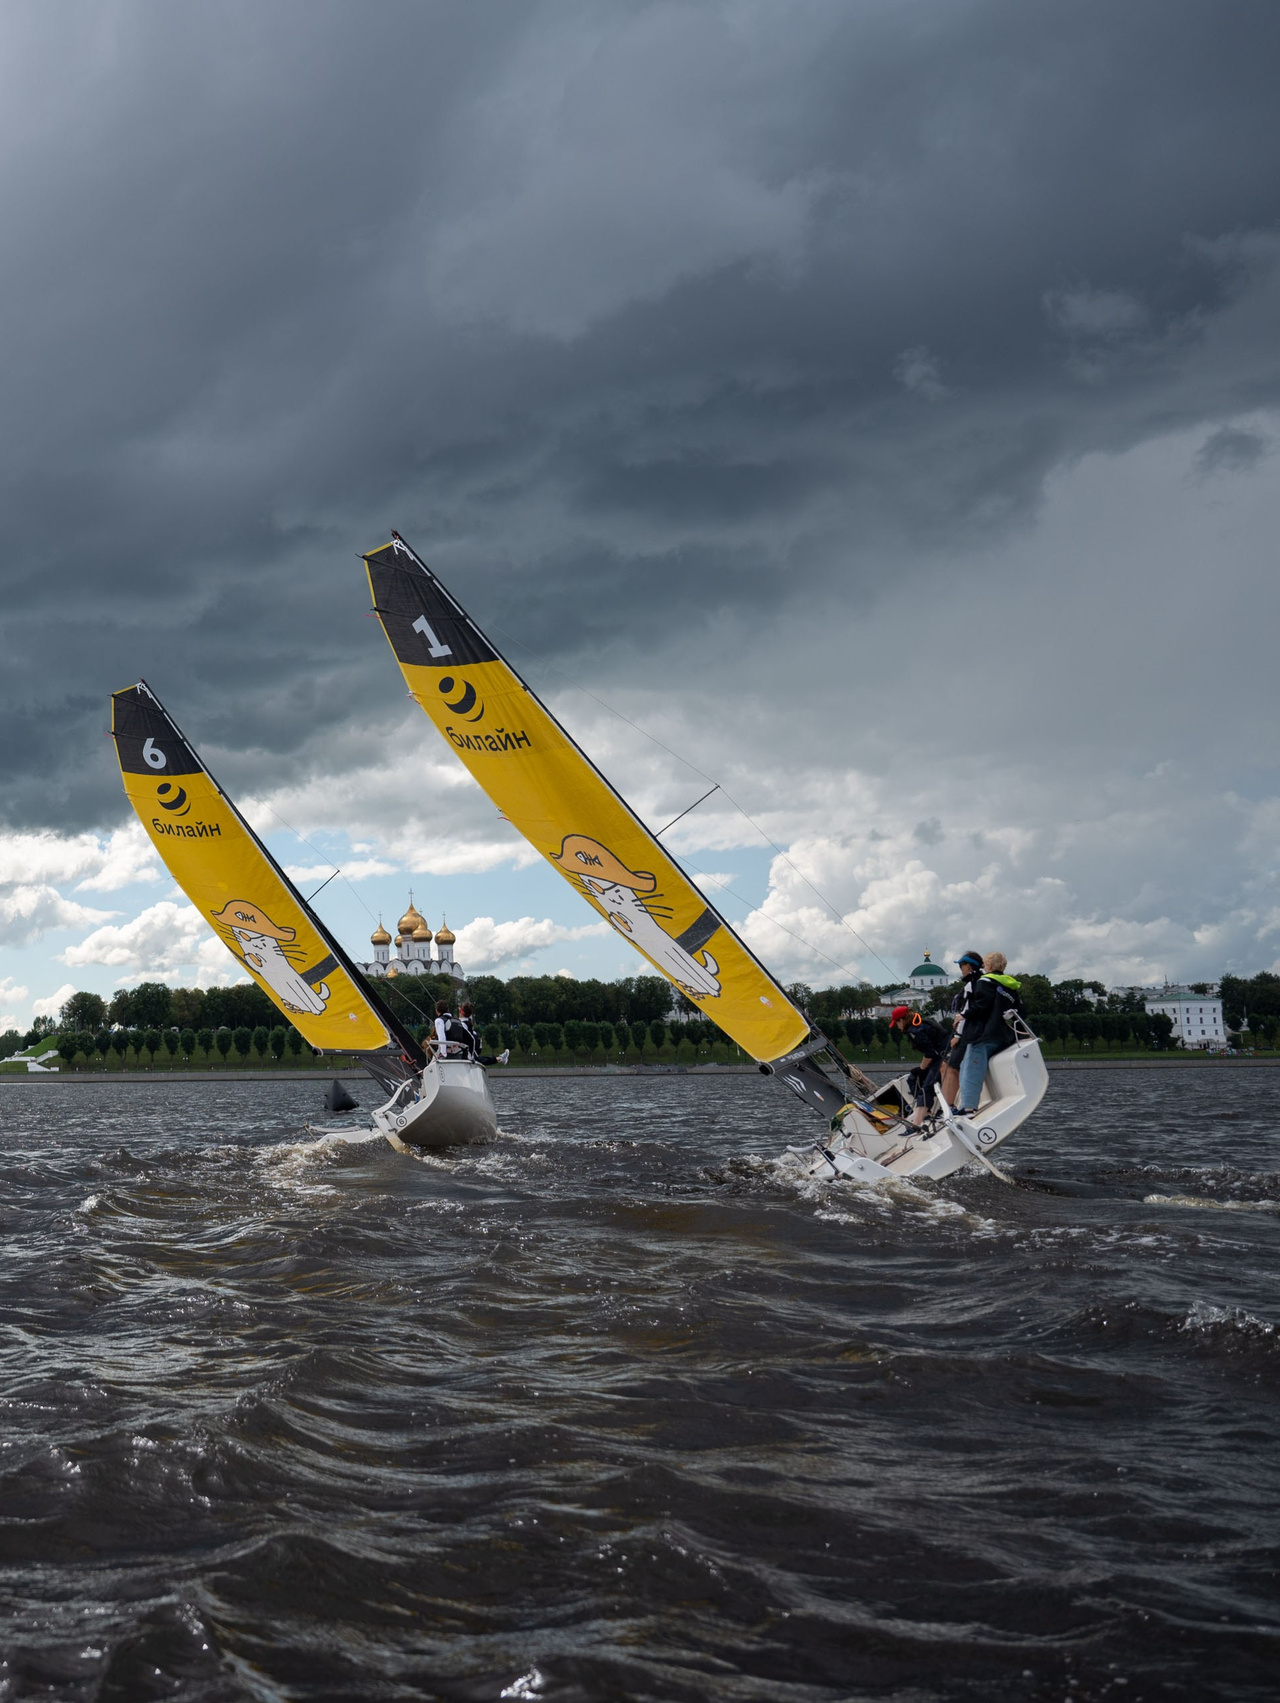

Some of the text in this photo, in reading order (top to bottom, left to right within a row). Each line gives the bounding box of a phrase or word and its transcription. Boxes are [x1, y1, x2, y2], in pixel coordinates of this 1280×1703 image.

[411, 614, 453, 658] 1
[142, 737, 167, 770] 6
[446, 726, 532, 753] билайн
[151, 817, 221, 839] билайн
